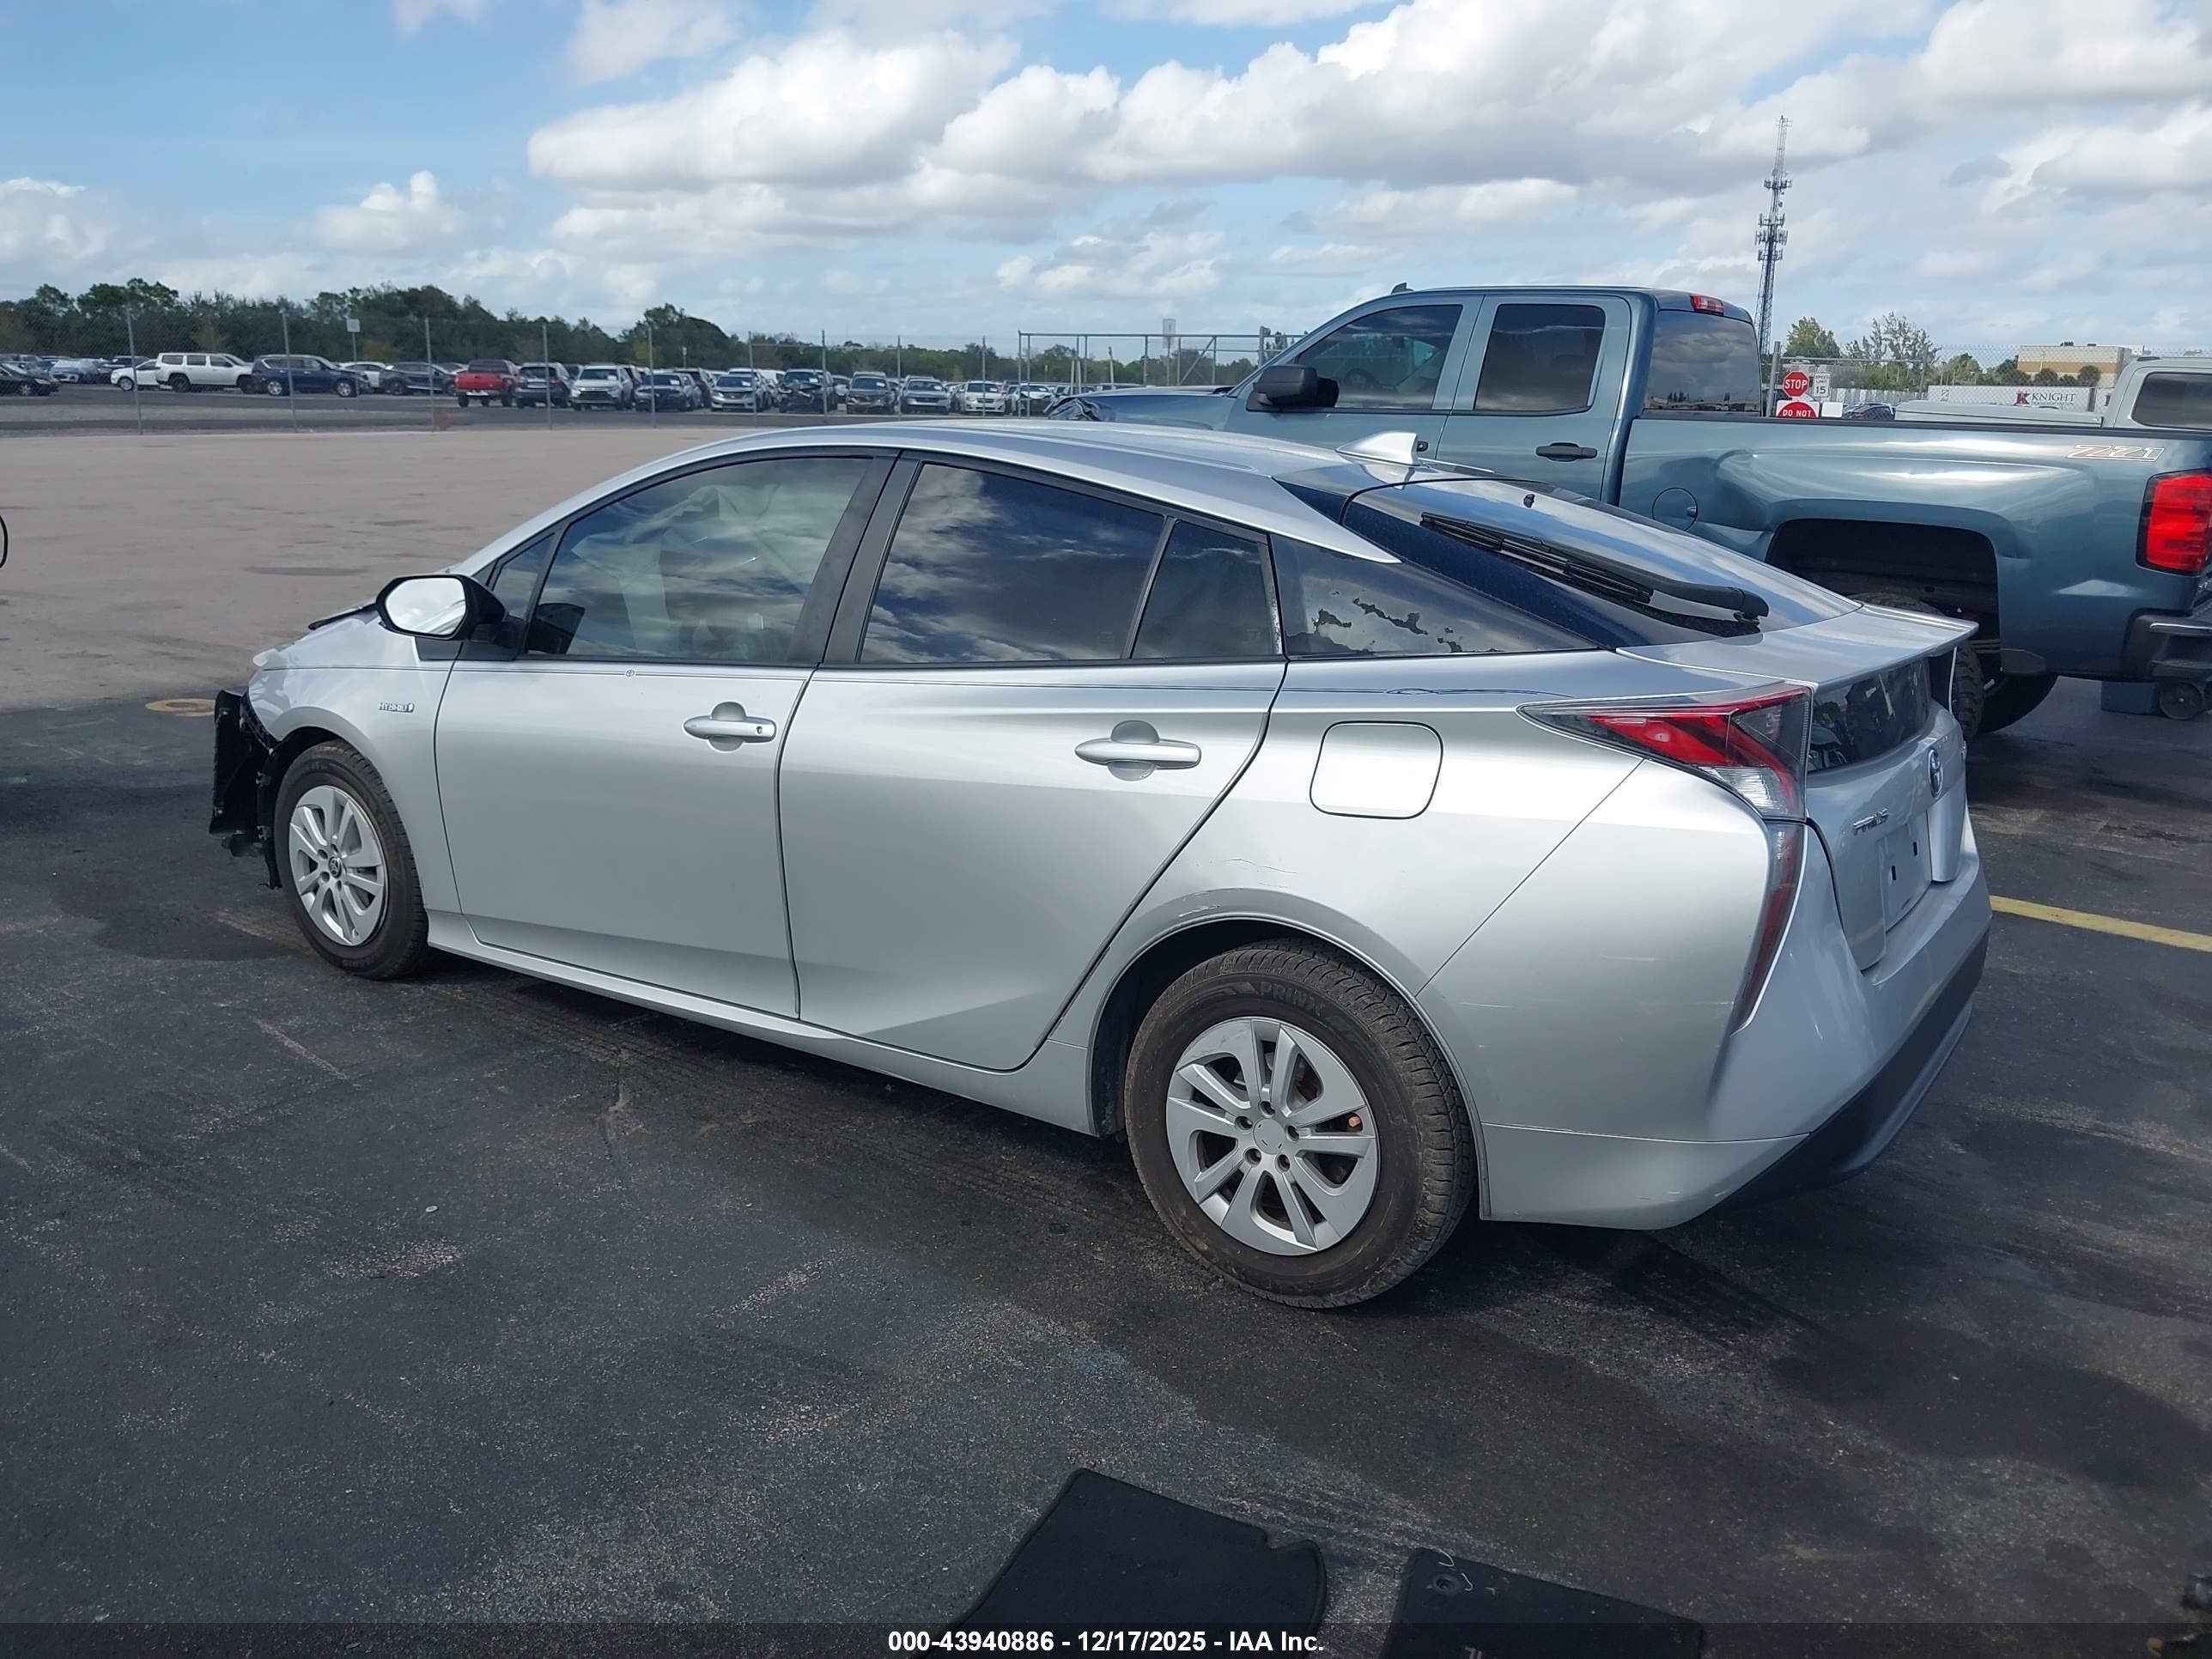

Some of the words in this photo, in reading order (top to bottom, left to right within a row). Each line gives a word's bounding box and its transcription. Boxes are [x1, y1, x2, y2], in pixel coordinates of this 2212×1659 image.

[1784, 380, 1808, 390] STOP
[2032, 392, 2076, 403] KNIGHT
[2067, 444, 2165, 462] Z71
